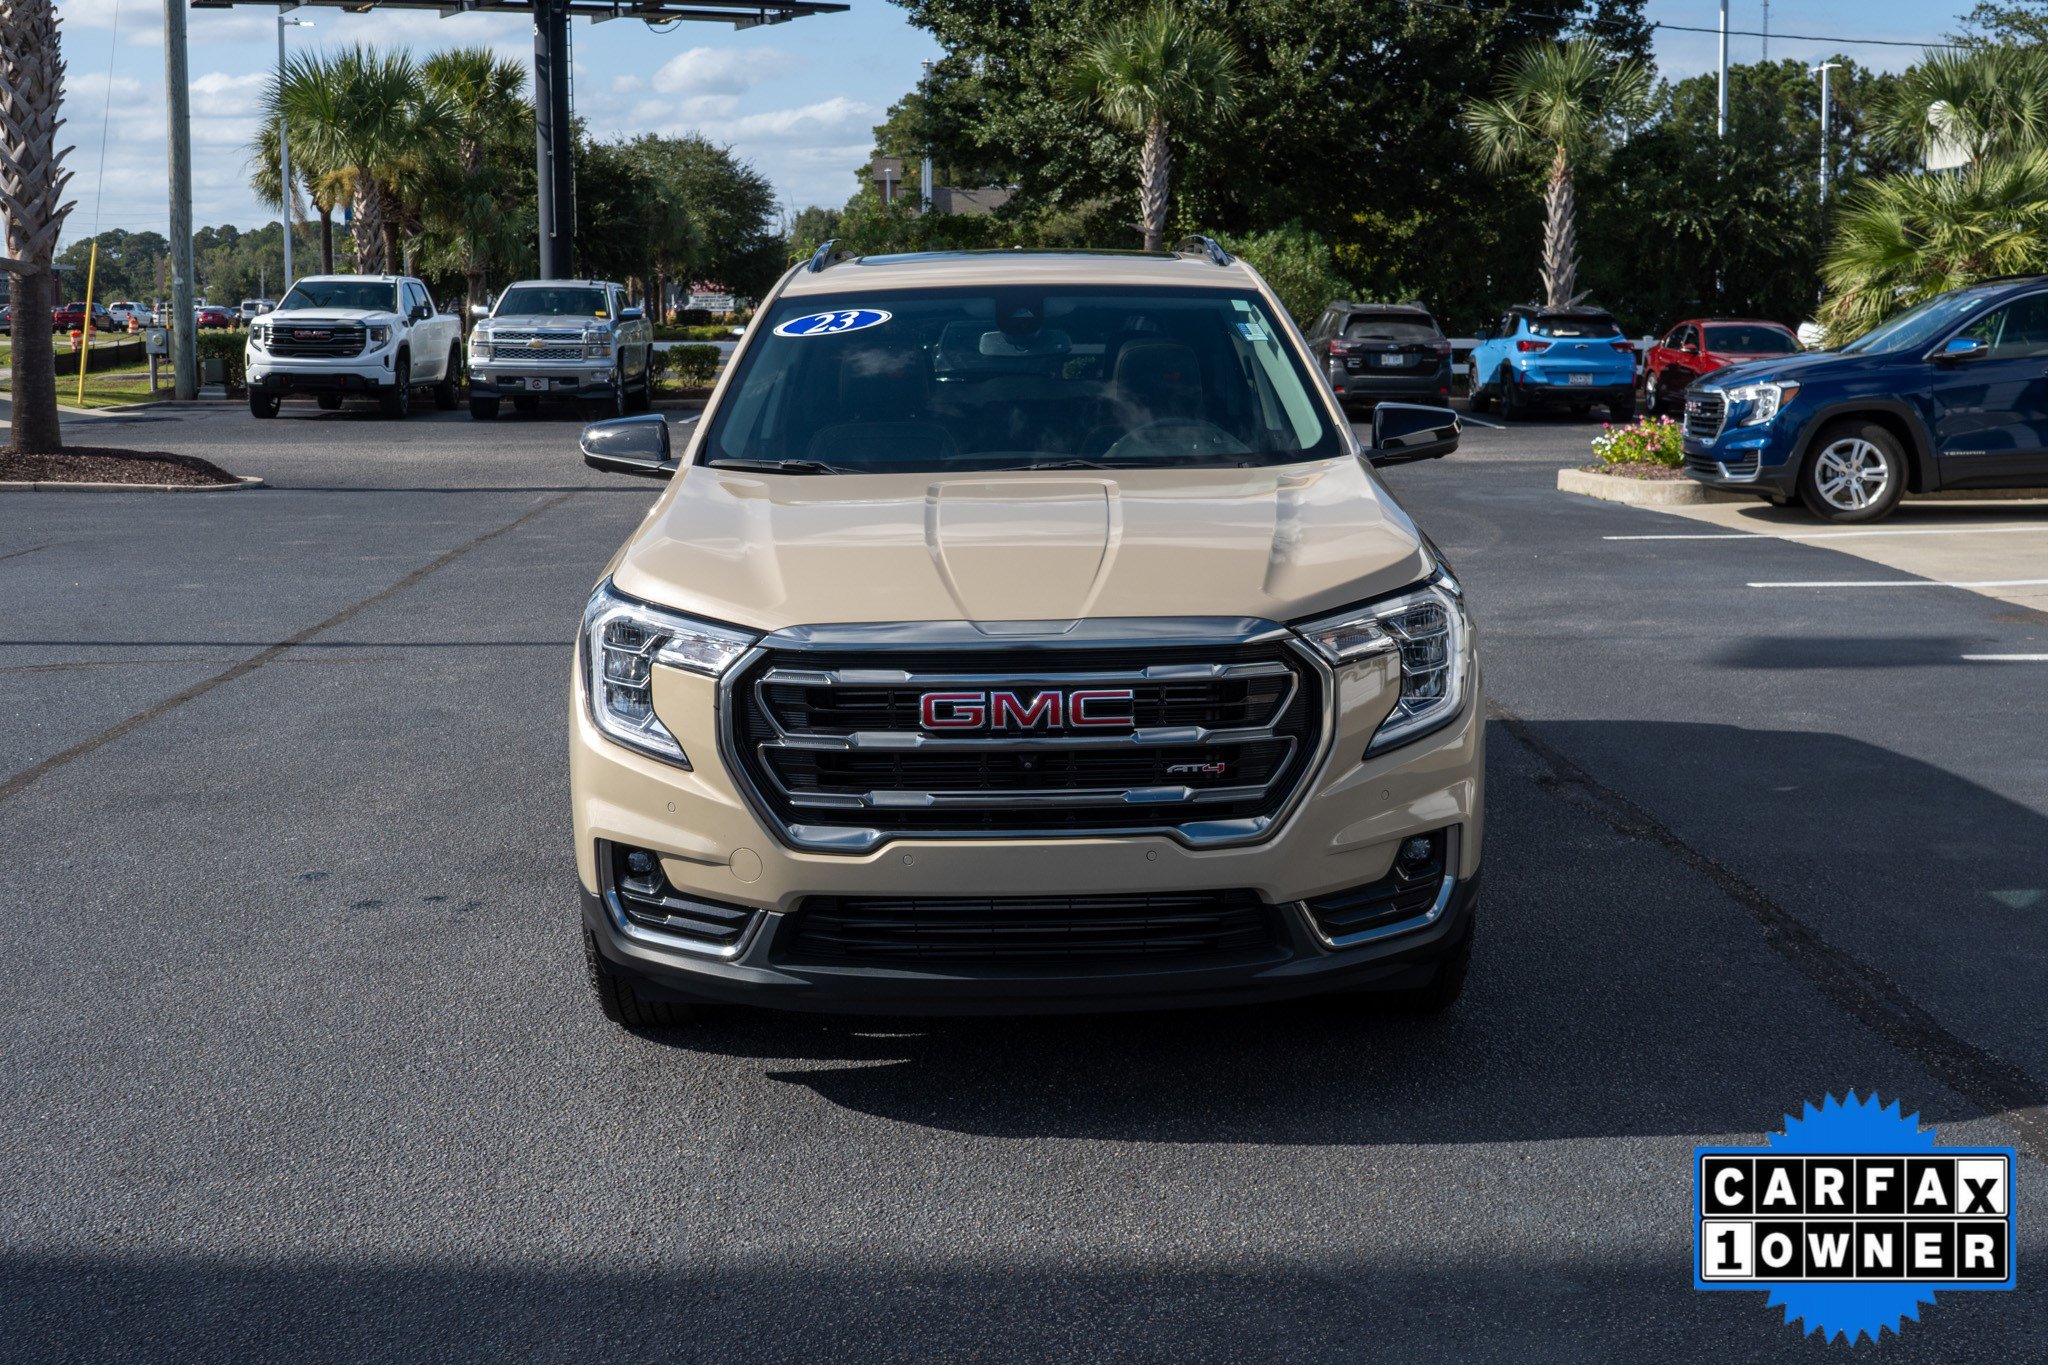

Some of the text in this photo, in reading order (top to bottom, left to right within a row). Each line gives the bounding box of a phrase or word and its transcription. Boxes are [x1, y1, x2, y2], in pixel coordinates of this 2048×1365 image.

[803, 311, 860, 334] 23
[919, 689, 1135, 730] GMC
[1166, 763, 1225, 773] AT4
